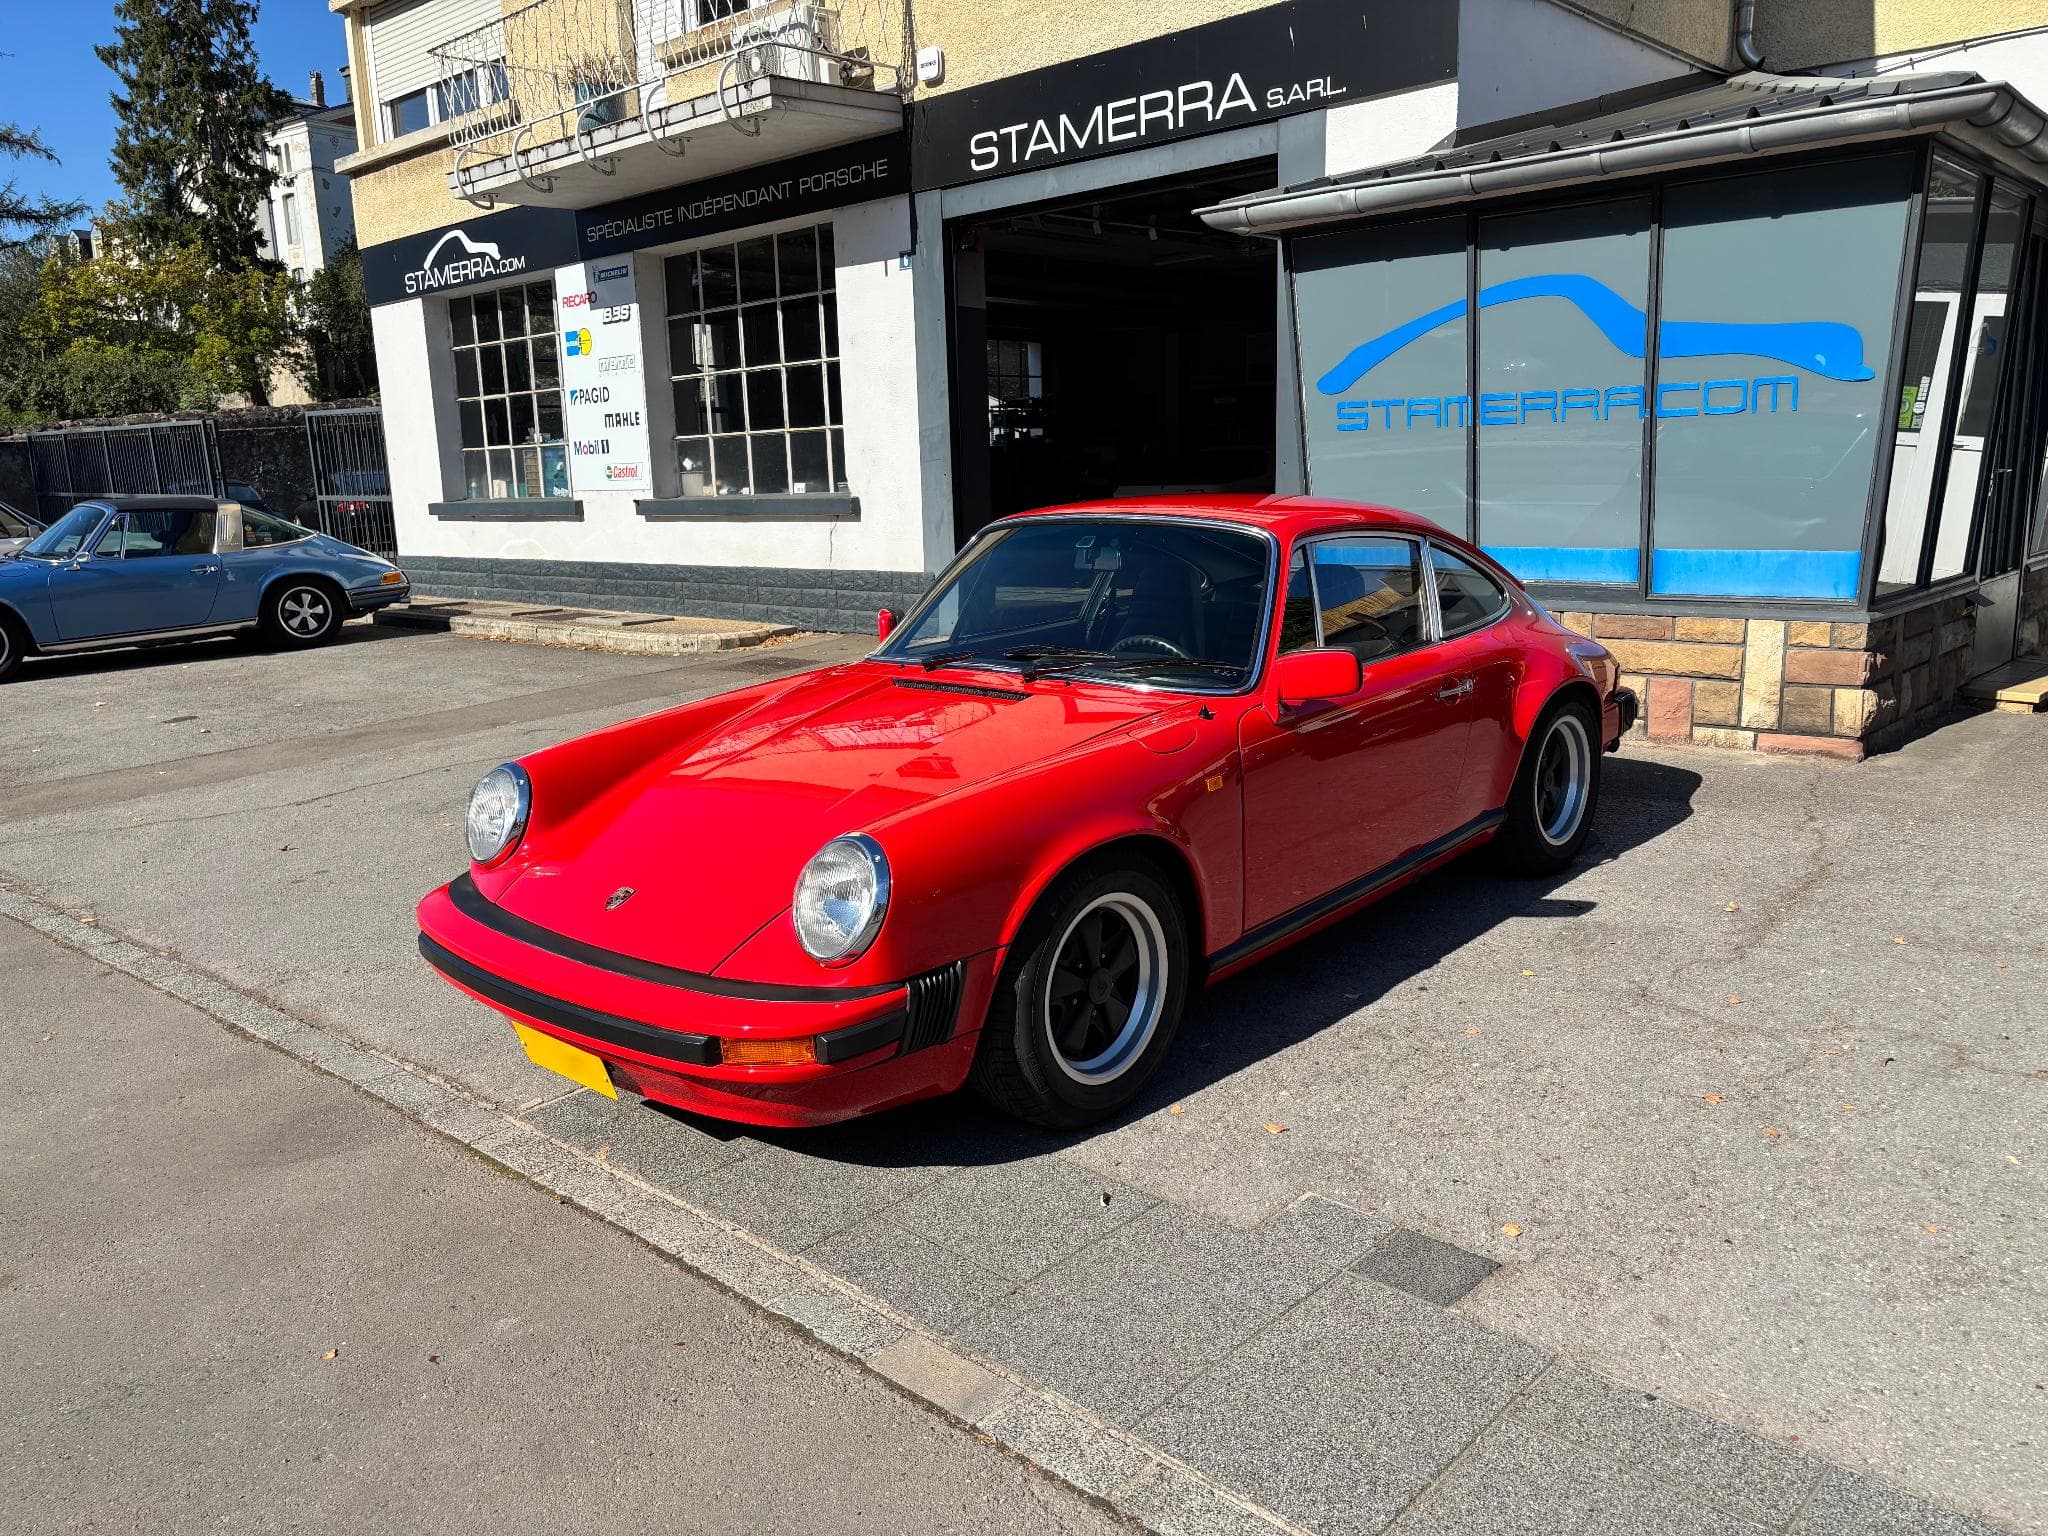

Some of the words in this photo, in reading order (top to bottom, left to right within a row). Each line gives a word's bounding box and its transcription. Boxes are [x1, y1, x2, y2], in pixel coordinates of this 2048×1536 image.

[970, 72, 1257, 171] STAMERRA
[1266, 76, 1347, 108] S.A.R.L.
[586, 208, 674, 242] SPÉCIALISTE
[677, 181, 793, 223] INDÉPENDANT
[799, 158, 888, 195] PORSCHE
[404, 255, 526, 294] STAMERRA.COM
[562, 291, 598, 309] RECARO
[579, 386, 610, 405] PAGID
[604, 411, 640, 428] MAHLE
[573, 440, 600, 456] Mobil
[613, 465, 638, 479] Castrol
